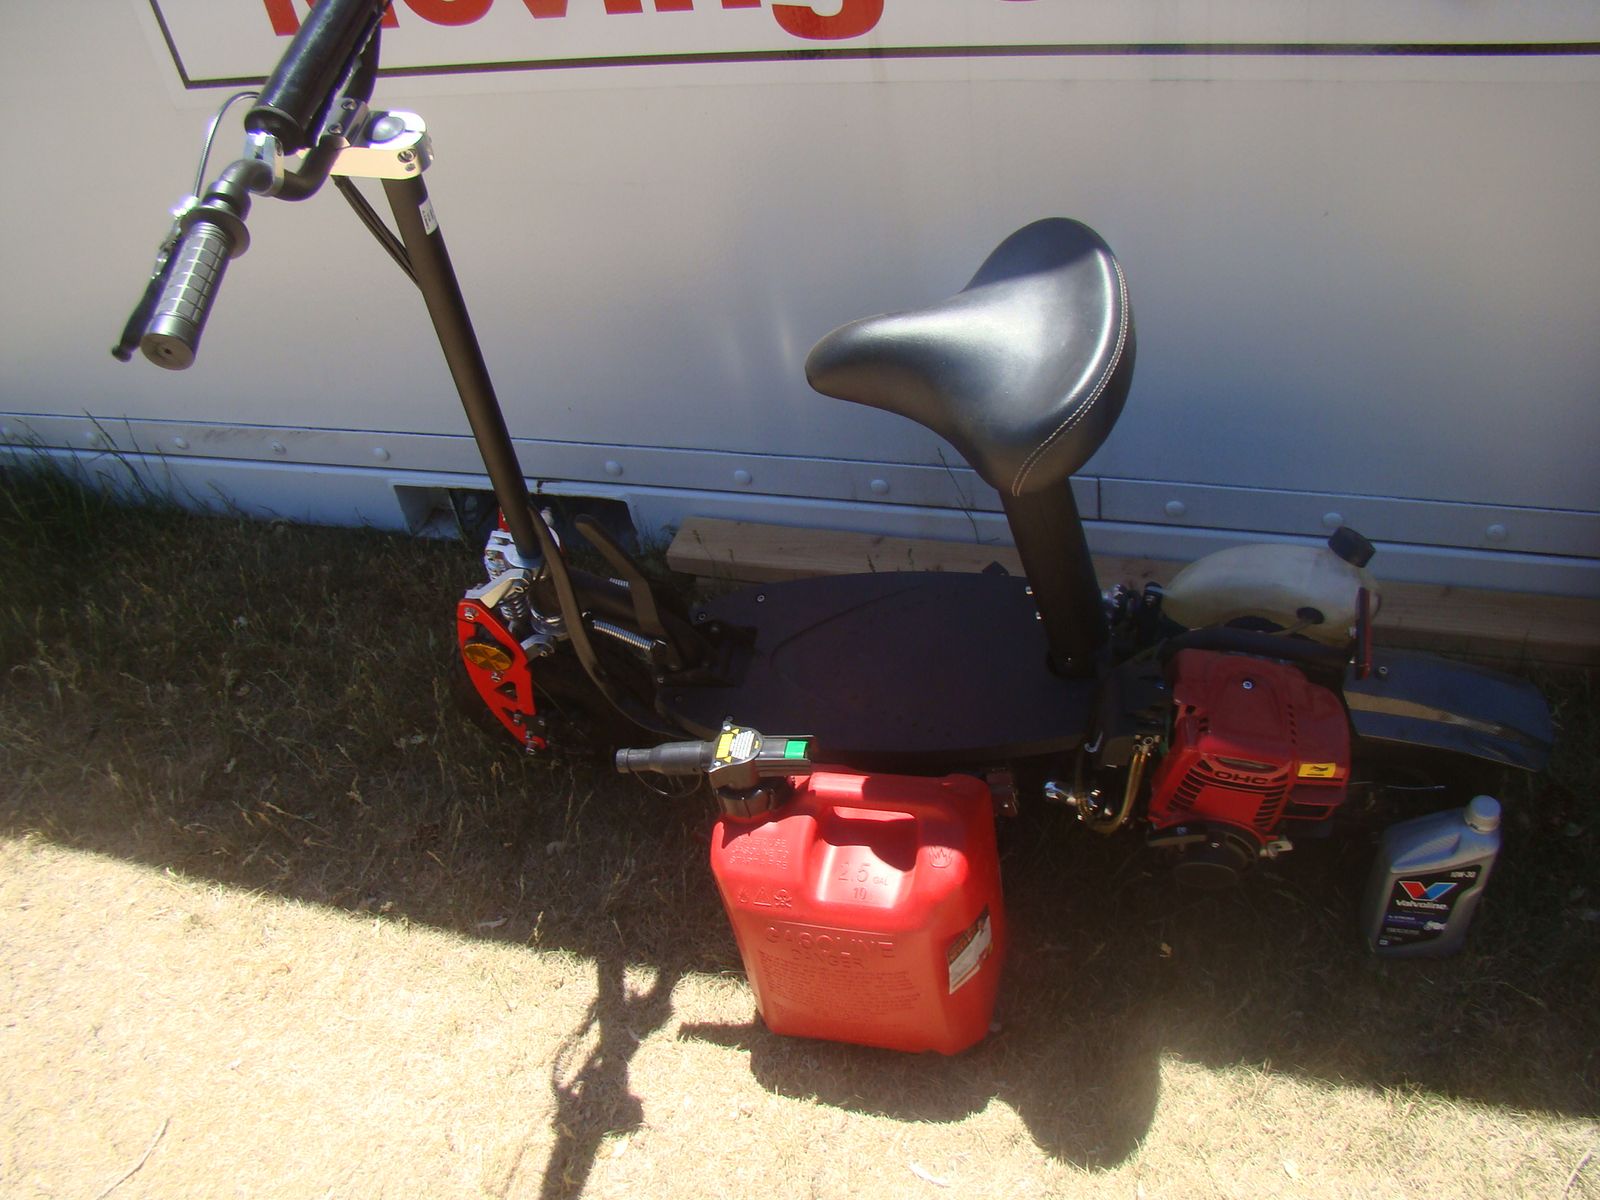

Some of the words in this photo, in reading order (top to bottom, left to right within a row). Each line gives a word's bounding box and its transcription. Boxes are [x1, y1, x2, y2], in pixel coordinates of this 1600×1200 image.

[1214, 770, 1268, 784] OHC
[838, 862, 871, 883] 2.5
[853, 887, 867, 900] 10
[1395, 899, 1448, 910] Valvoline
[766, 926, 896, 959] GASOLINE
[791, 949, 864, 969] DANGER
